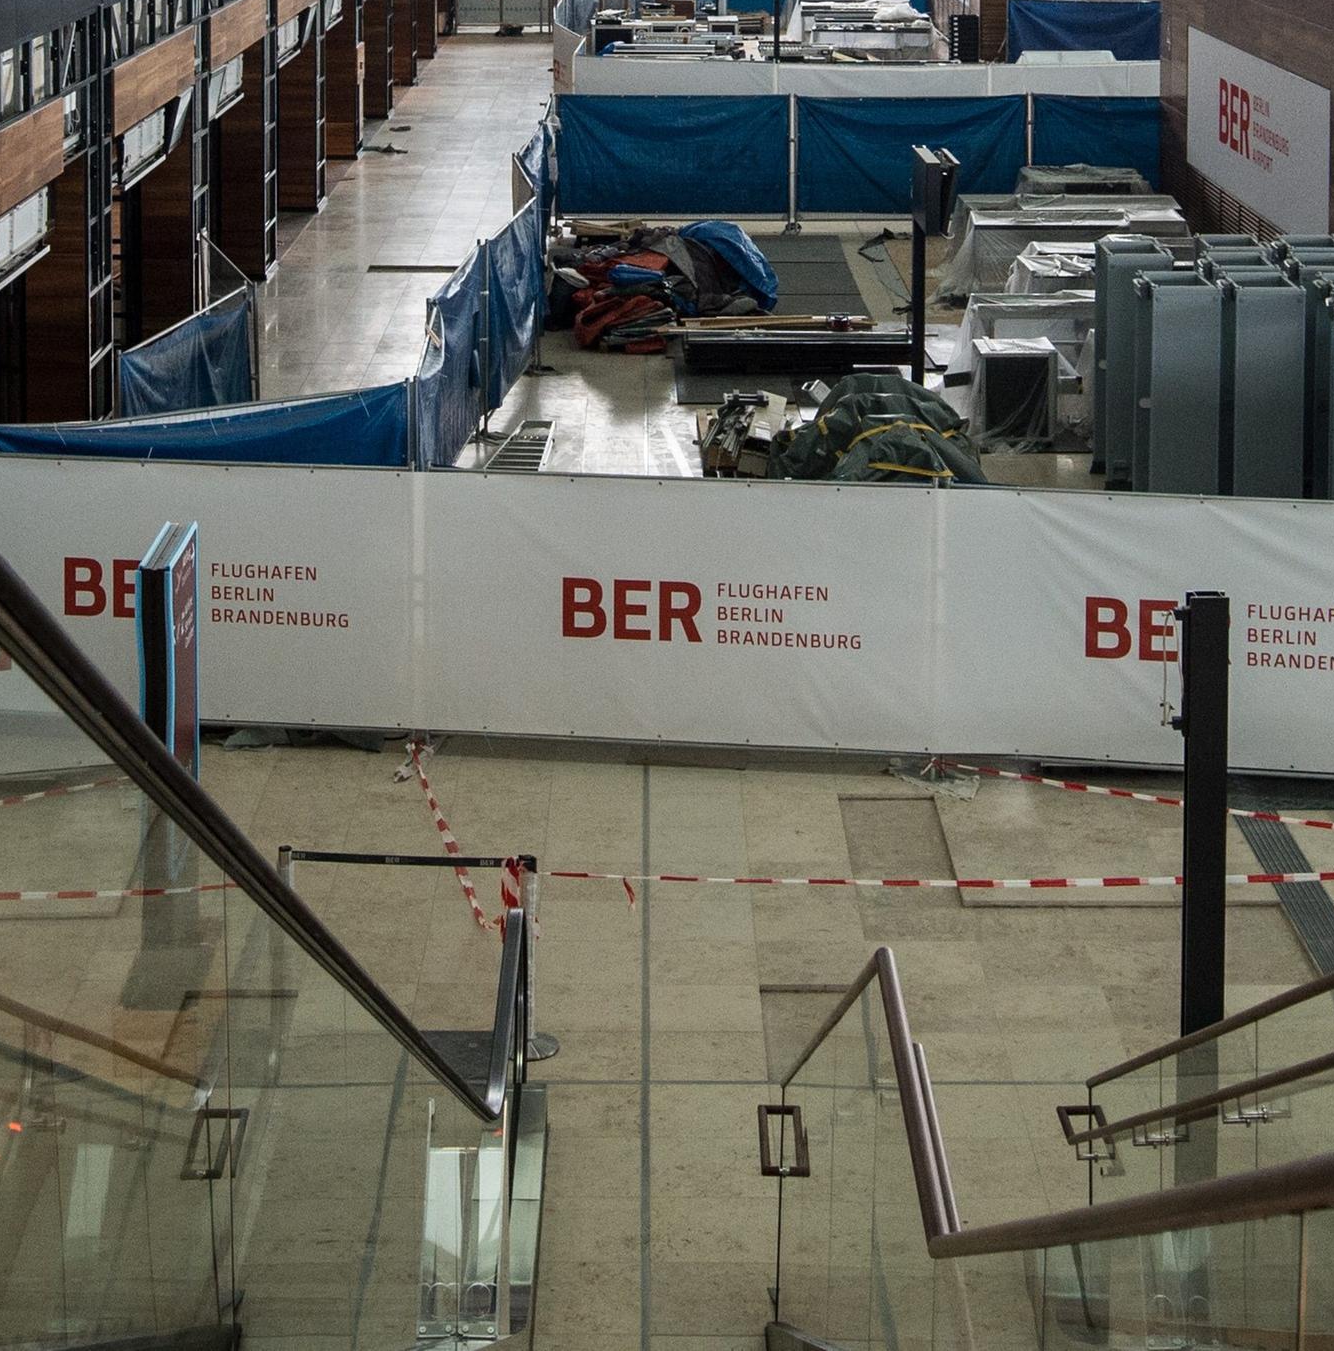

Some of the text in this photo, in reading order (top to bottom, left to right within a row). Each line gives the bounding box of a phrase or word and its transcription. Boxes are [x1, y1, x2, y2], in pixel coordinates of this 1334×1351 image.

[1219, 77, 1250, 160] BER
[211, 562, 317, 581] FLUGHAFEN
[64, 556, 142, 619] BE
[211, 585, 275, 603] BERLIN
[717, 583, 828, 601] FLUGHAFEN
[211, 608, 349, 628] BRANDENBURG
[562, 577, 703, 643] BER
[717, 606, 784, 623] BERLIN
[717, 629, 862, 649] BRANDENBURG
[1084, 595, 1179, 663] BE
[1247, 628, 1316, 646] BERLIN
